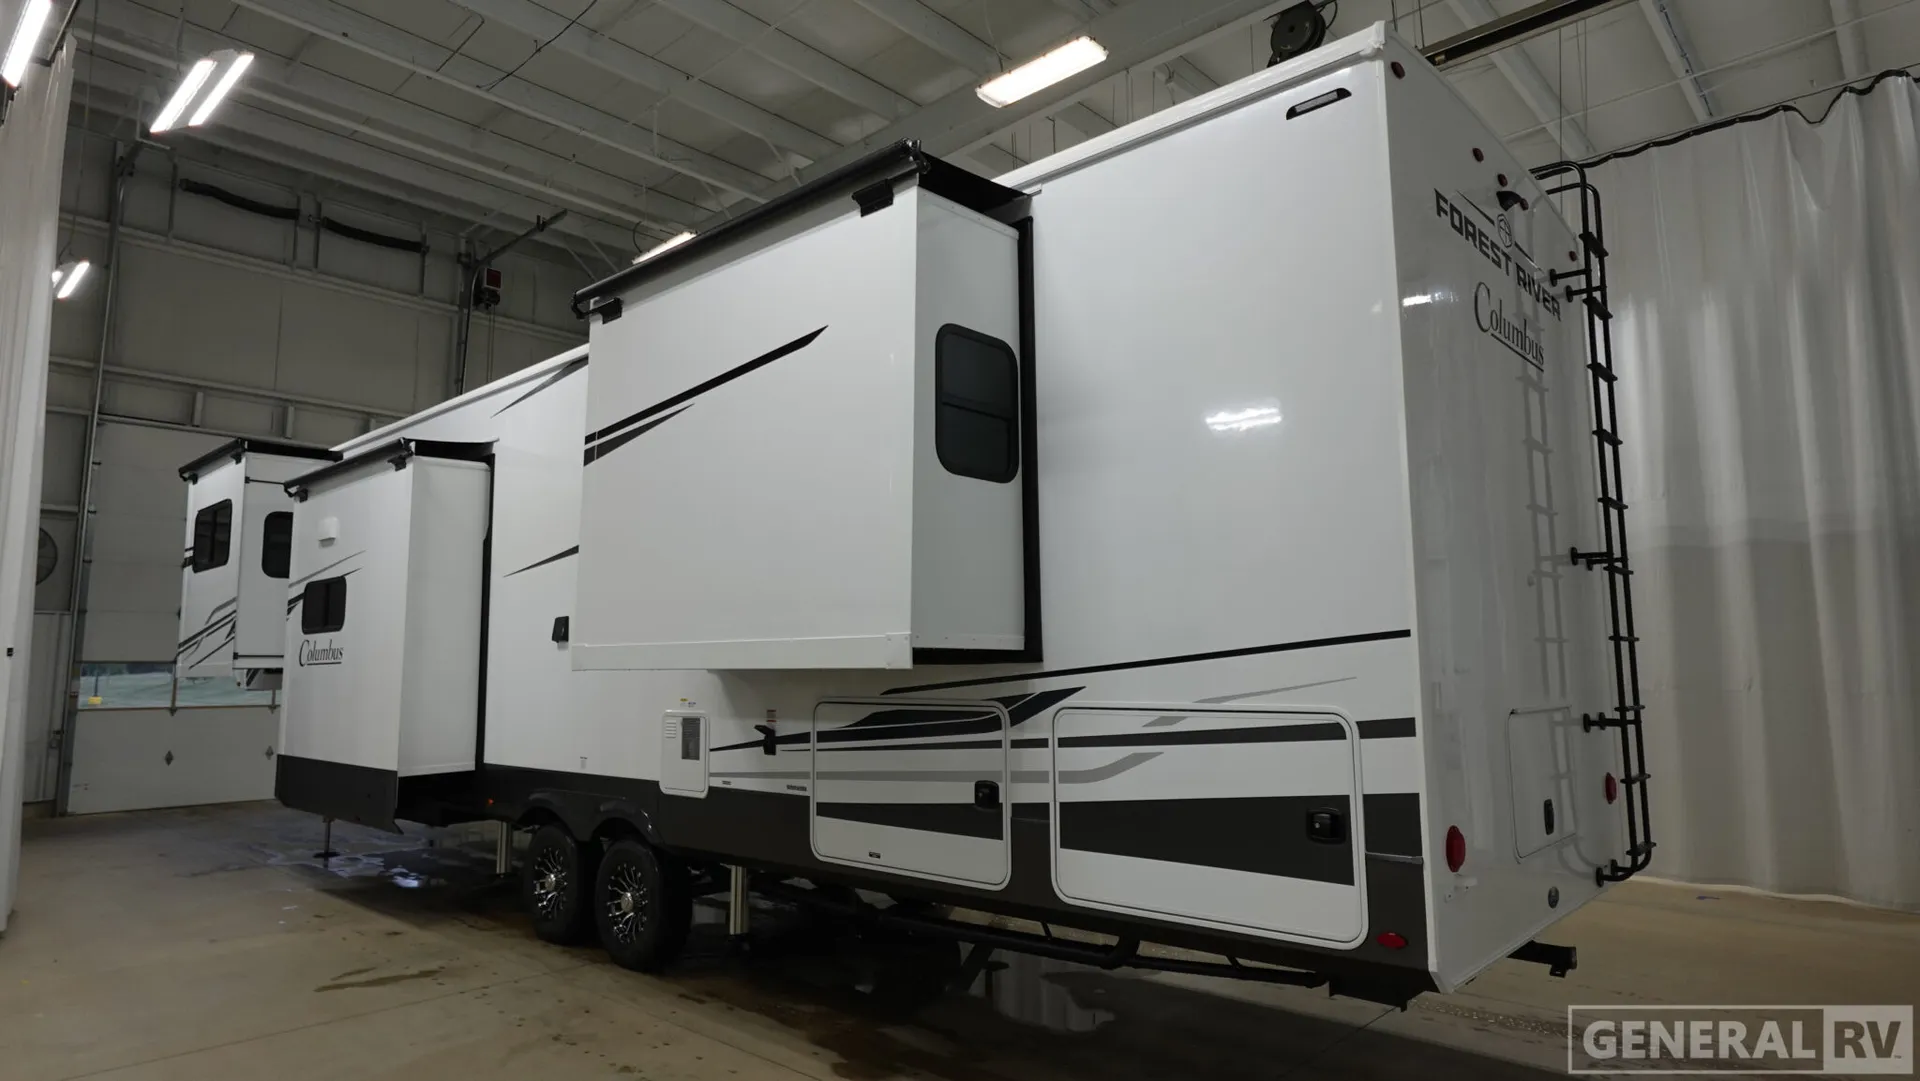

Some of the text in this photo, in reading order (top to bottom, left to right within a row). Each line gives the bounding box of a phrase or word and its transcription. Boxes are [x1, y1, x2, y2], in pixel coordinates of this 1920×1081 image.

[1434, 188, 1561, 321] FOREST RIVER
[1475, 282, 1544, 366] Columbus
[299, 638, 344, 667] Columbus
